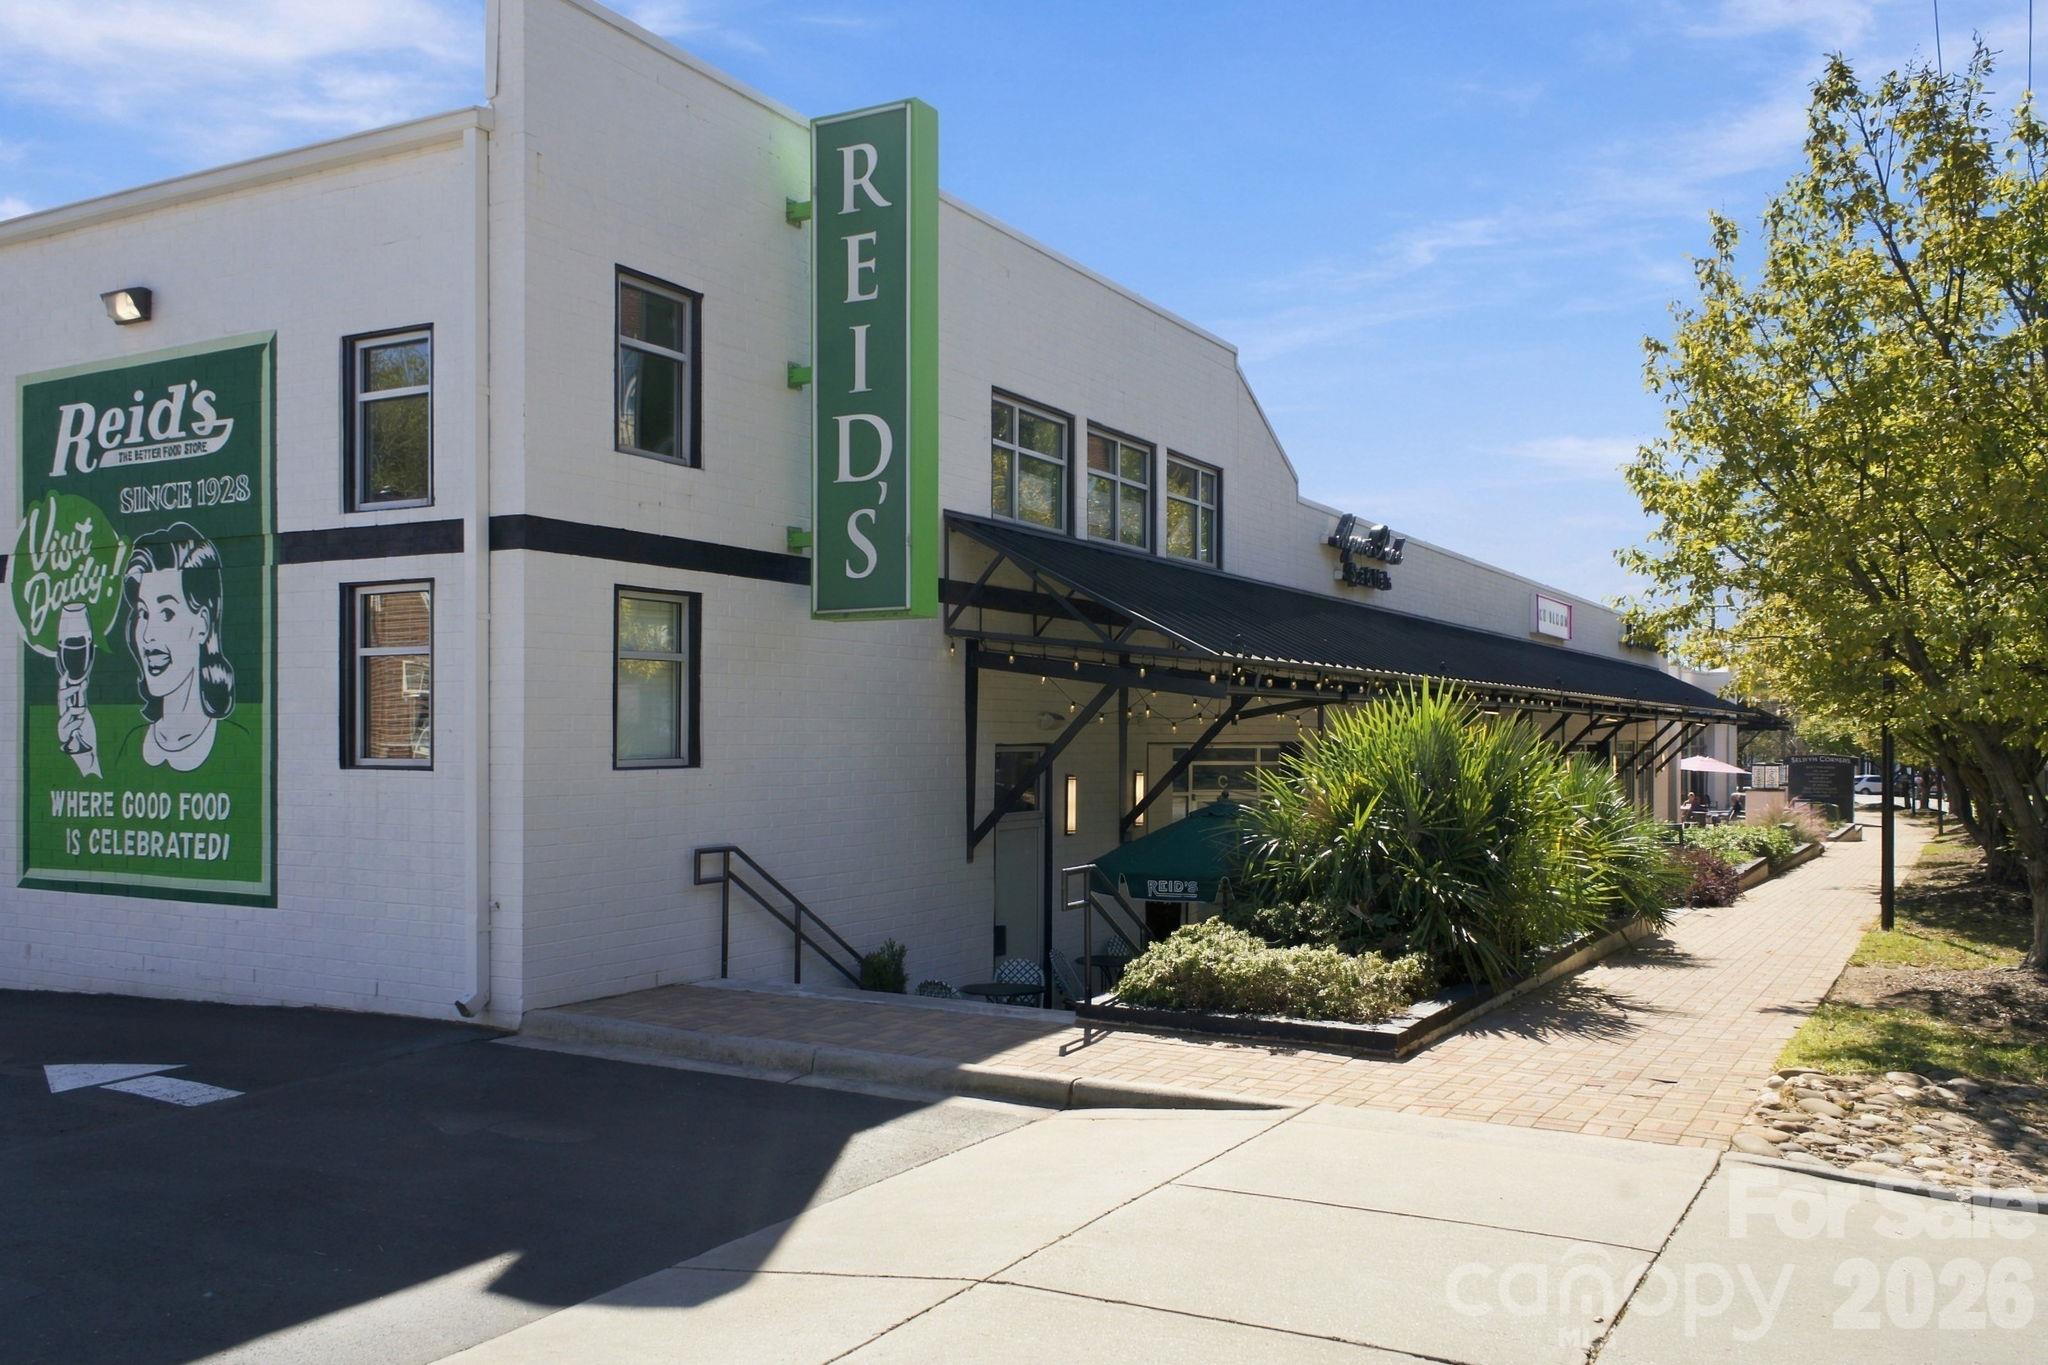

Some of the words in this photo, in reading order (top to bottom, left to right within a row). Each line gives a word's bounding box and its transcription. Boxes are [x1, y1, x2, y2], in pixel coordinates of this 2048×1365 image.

[832, 142, 893, 580] REID'S
[49, 379, 234, 477] Reid's
[118, 450, 133, 463] THE
[134, 447, 162, 461] BETTER
[163, 444, 182, 458] FOOD
[184, 441, 208, 455] STORE
[120, 480, 192, 514] SINCE
[197, 474, 251, 507] 1928
[29, 497, 93, 571] Visit
[1217, 775, 1229, 788] C
[50, 790, 114, 818] WHERE
[122, 791, 171, 819] GOOD
[179, 792, 231, 821] FOOD
[66, 828, 81, 856] IS
[89, 828, 230, 861] CELEBRATED!
[1148, 879, 1198, 897] REID'S
